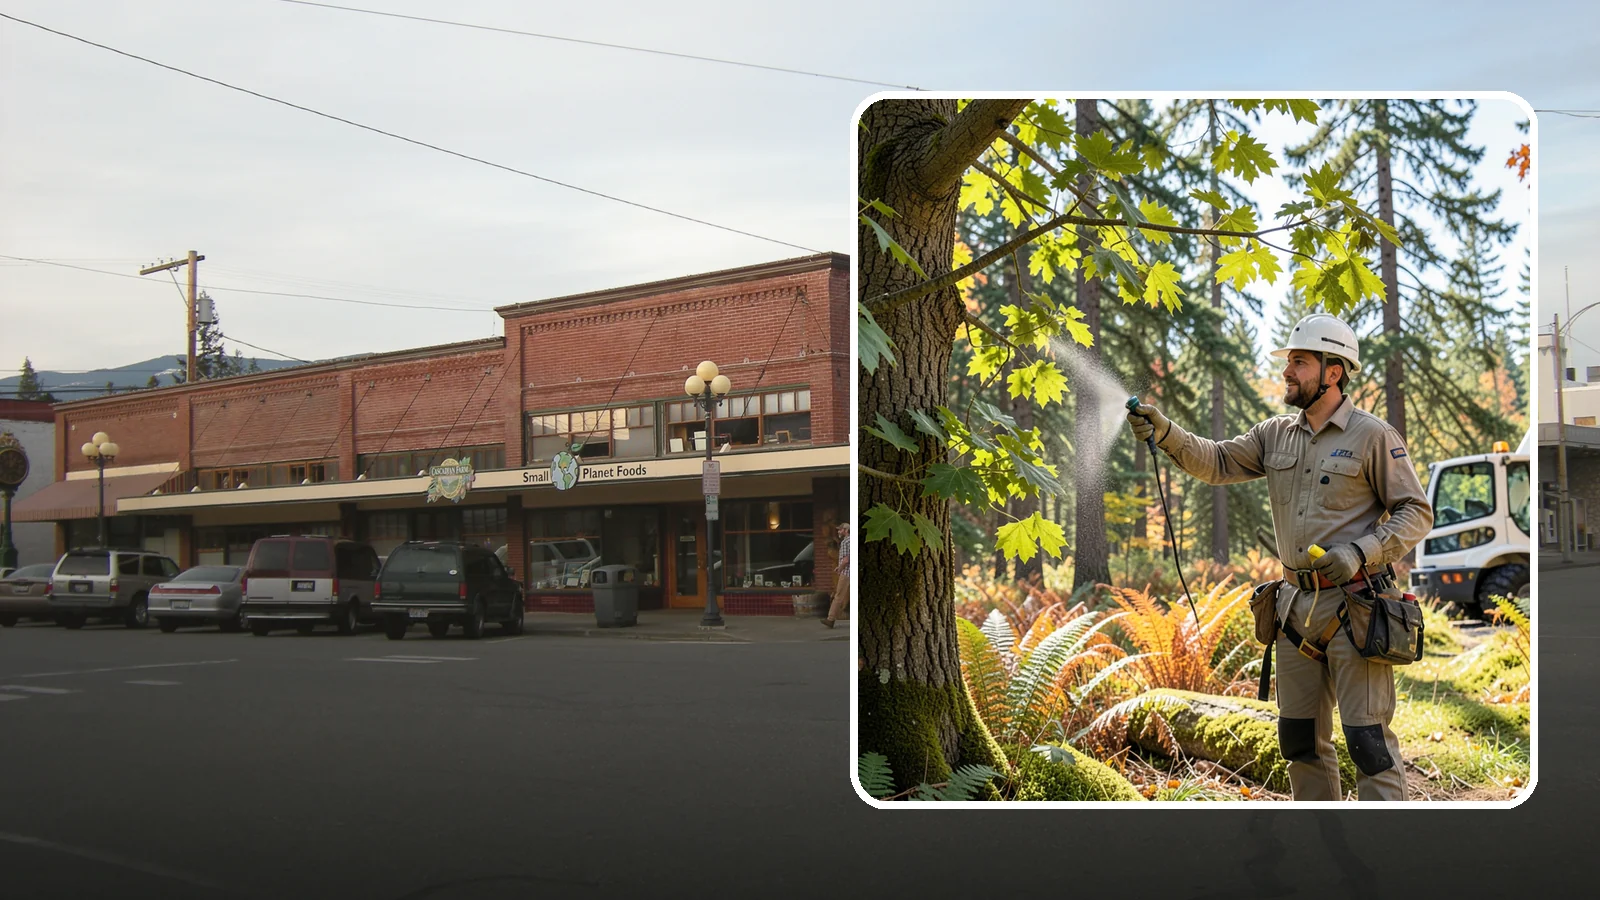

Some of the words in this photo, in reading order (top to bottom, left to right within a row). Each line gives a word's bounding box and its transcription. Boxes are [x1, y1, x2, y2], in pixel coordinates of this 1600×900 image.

[523, 471, 549, 482] Small
[583, 467, 614, 479] Planet
[617, 464, 647, 477] Foods
